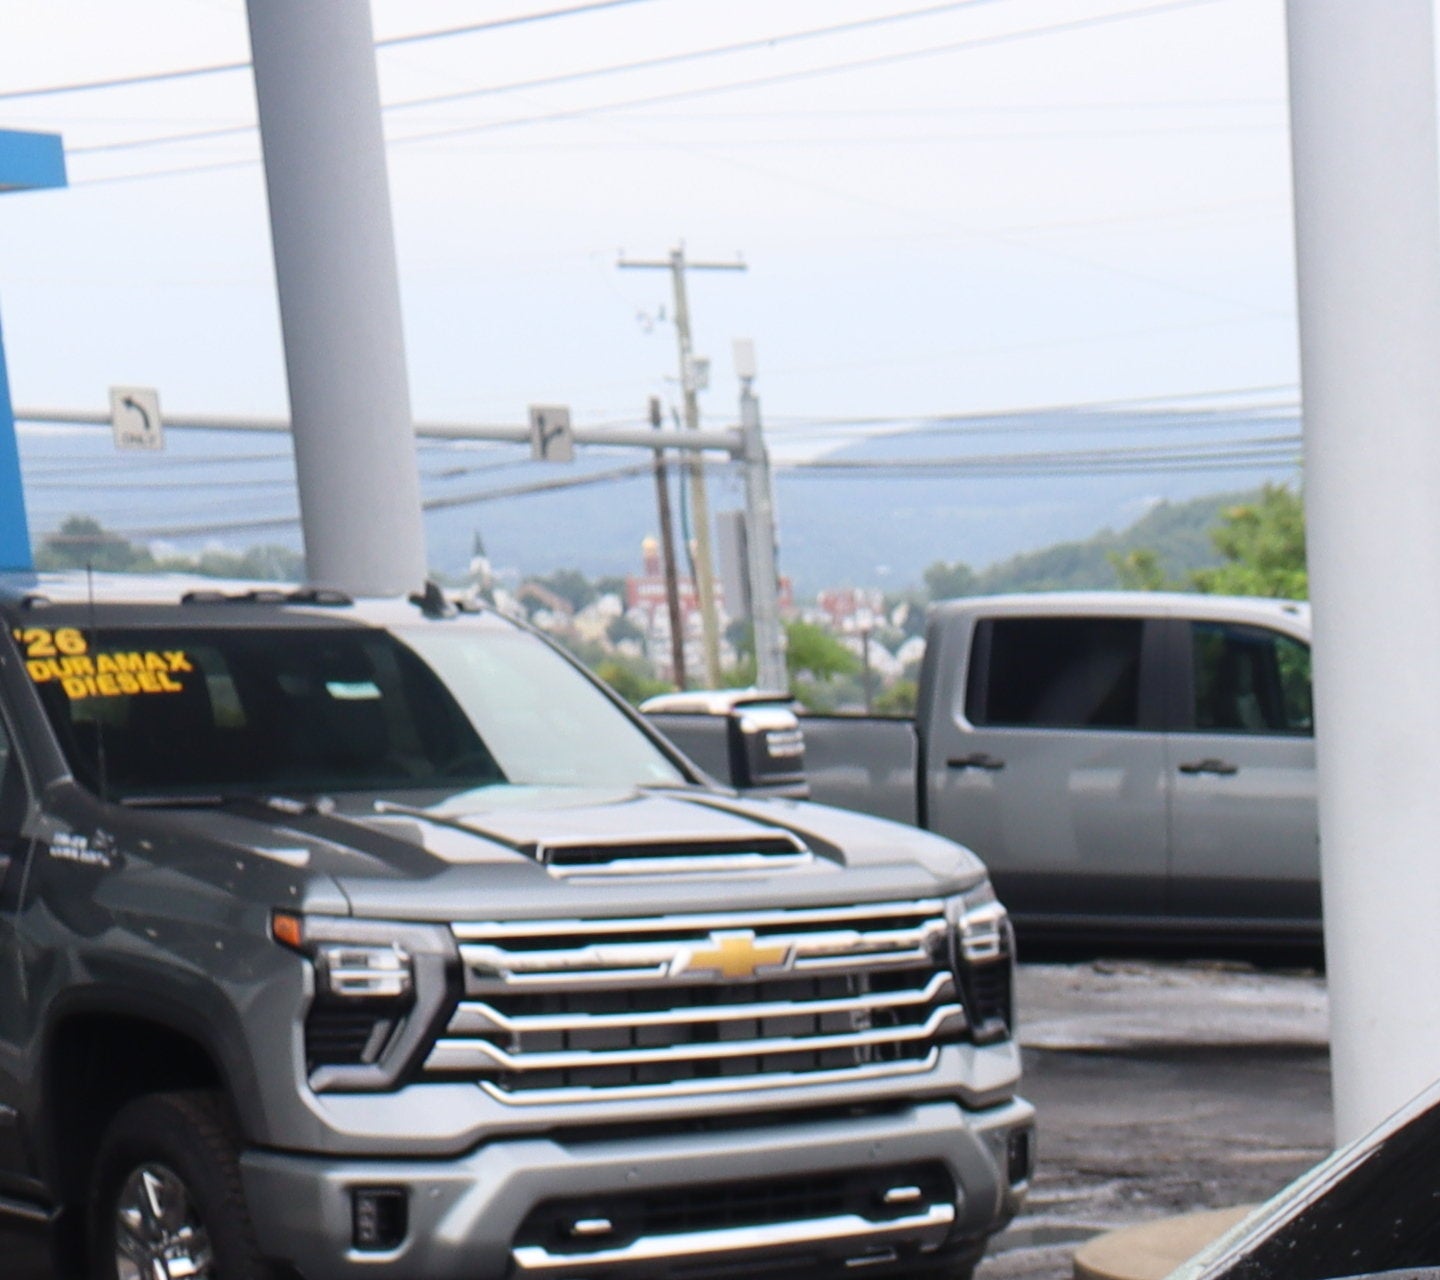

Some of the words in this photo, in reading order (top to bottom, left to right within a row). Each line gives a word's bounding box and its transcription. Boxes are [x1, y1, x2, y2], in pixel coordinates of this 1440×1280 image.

[13, 627, 88, 657] '26
[25, 650, 194, 683] DURAMAX
[60, 671, 183, 700] DIESEL
